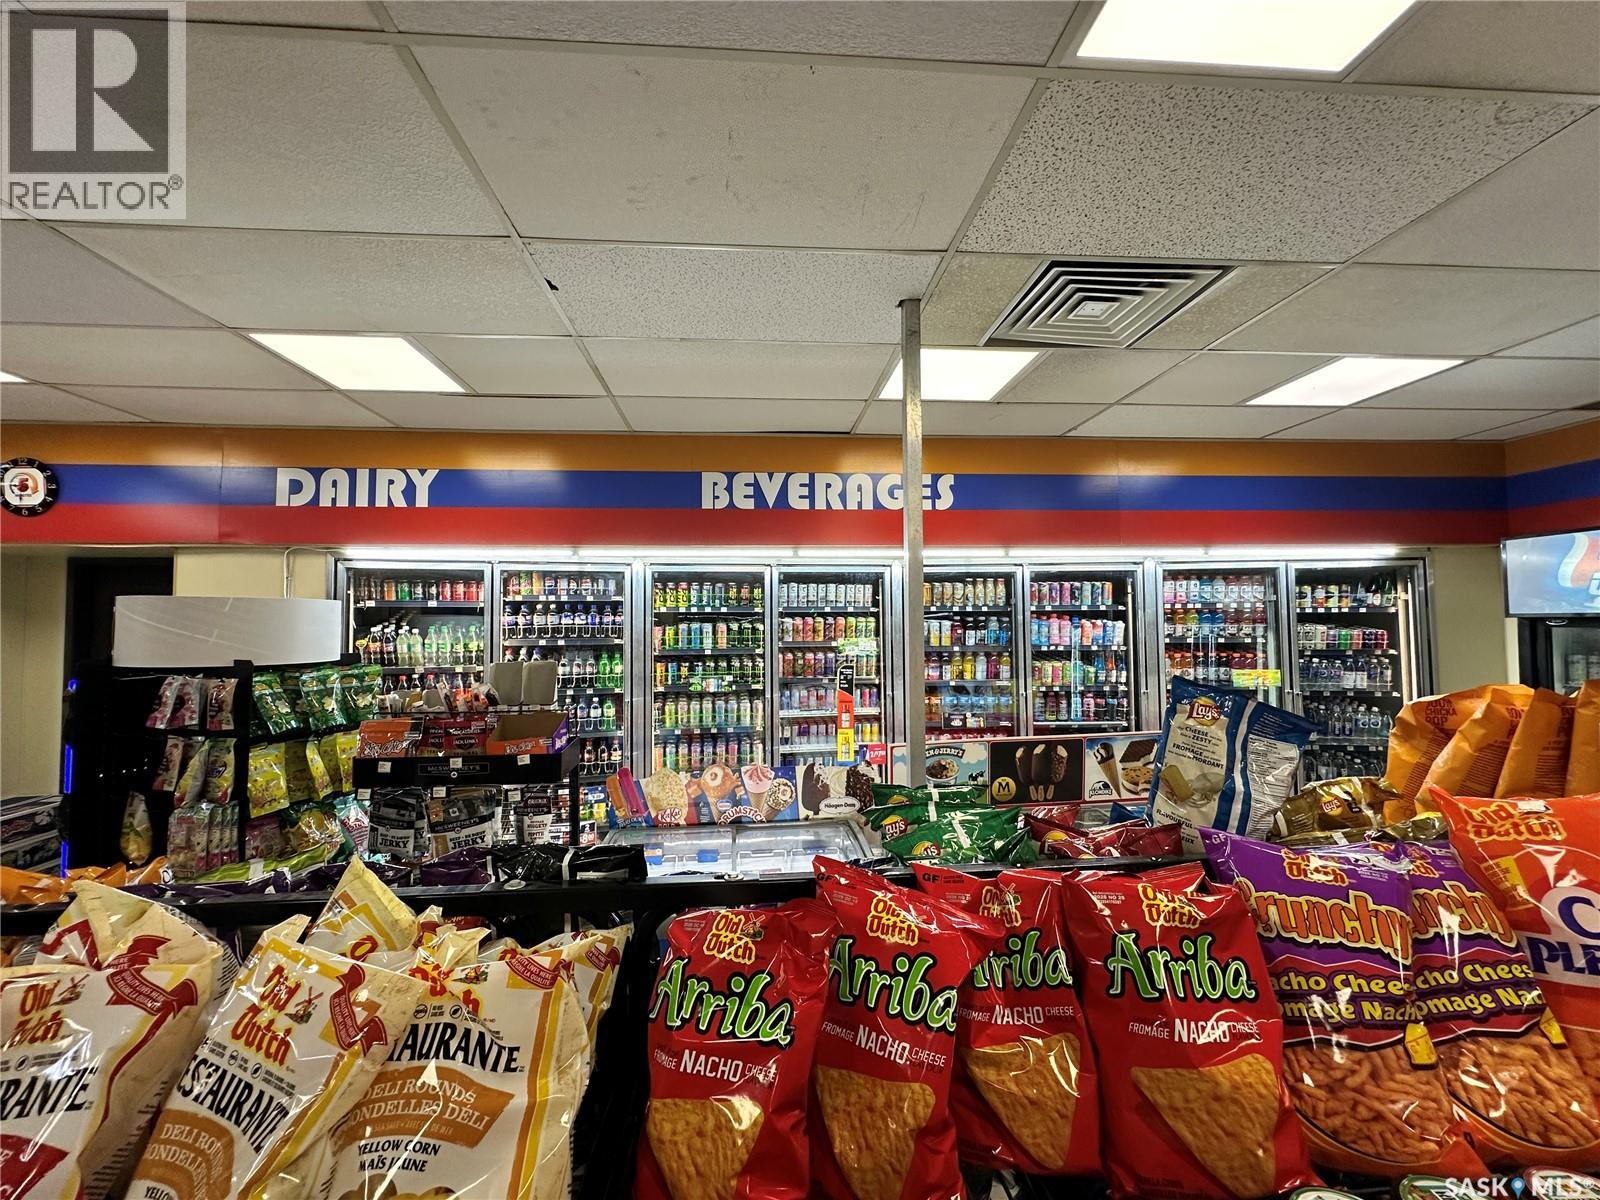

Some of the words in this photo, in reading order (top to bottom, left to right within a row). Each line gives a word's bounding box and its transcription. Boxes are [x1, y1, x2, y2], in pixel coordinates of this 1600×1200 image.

[275, 467, 441, 508] DAIRY
[1192, 735, 1213, 745] ZESTY
[379, 837, 410, 849] JERKY
[451, 835, 487, 849] JERKY
[713, 912, 745, 935] Old
[865, 914, 919, 946] Dutch
[973, 930, 1073, 988] riba
[1106, 932, 1256, 999] Arriba
[828, 938, 958, 1032] Arriba
[1271, 971, 1327, 991] acho
[1464, 963, 1535, 984] Chees
[648, 959, 792, 1045] Arriba
[991, 1004, 1044, 1025] NACHO
[1045, 1006, 1074, 1016] CHEESE
[231, 1003, 293, 1066] Dutch
[1128, 1021, 1170, 1040] FROMAGE
[821, 1021, 855, 1042] FROMAGE
[855, 1024, 910, 1065] NACHO
[911, 1047, 947, 1067] CHEESE
[679, 1049, 744, 1083] NACHO
[401, 1078, 477, 1105] ROUNDS
[442, 1101, 491, 1132] DÉLI
[160, 1123, 198, 1144] DELI
[357, 1139, 404, 1157] YELLOW
[404, 1139, 442, 1157] CORN
[145, 1185, 171, 1200] YELLO
